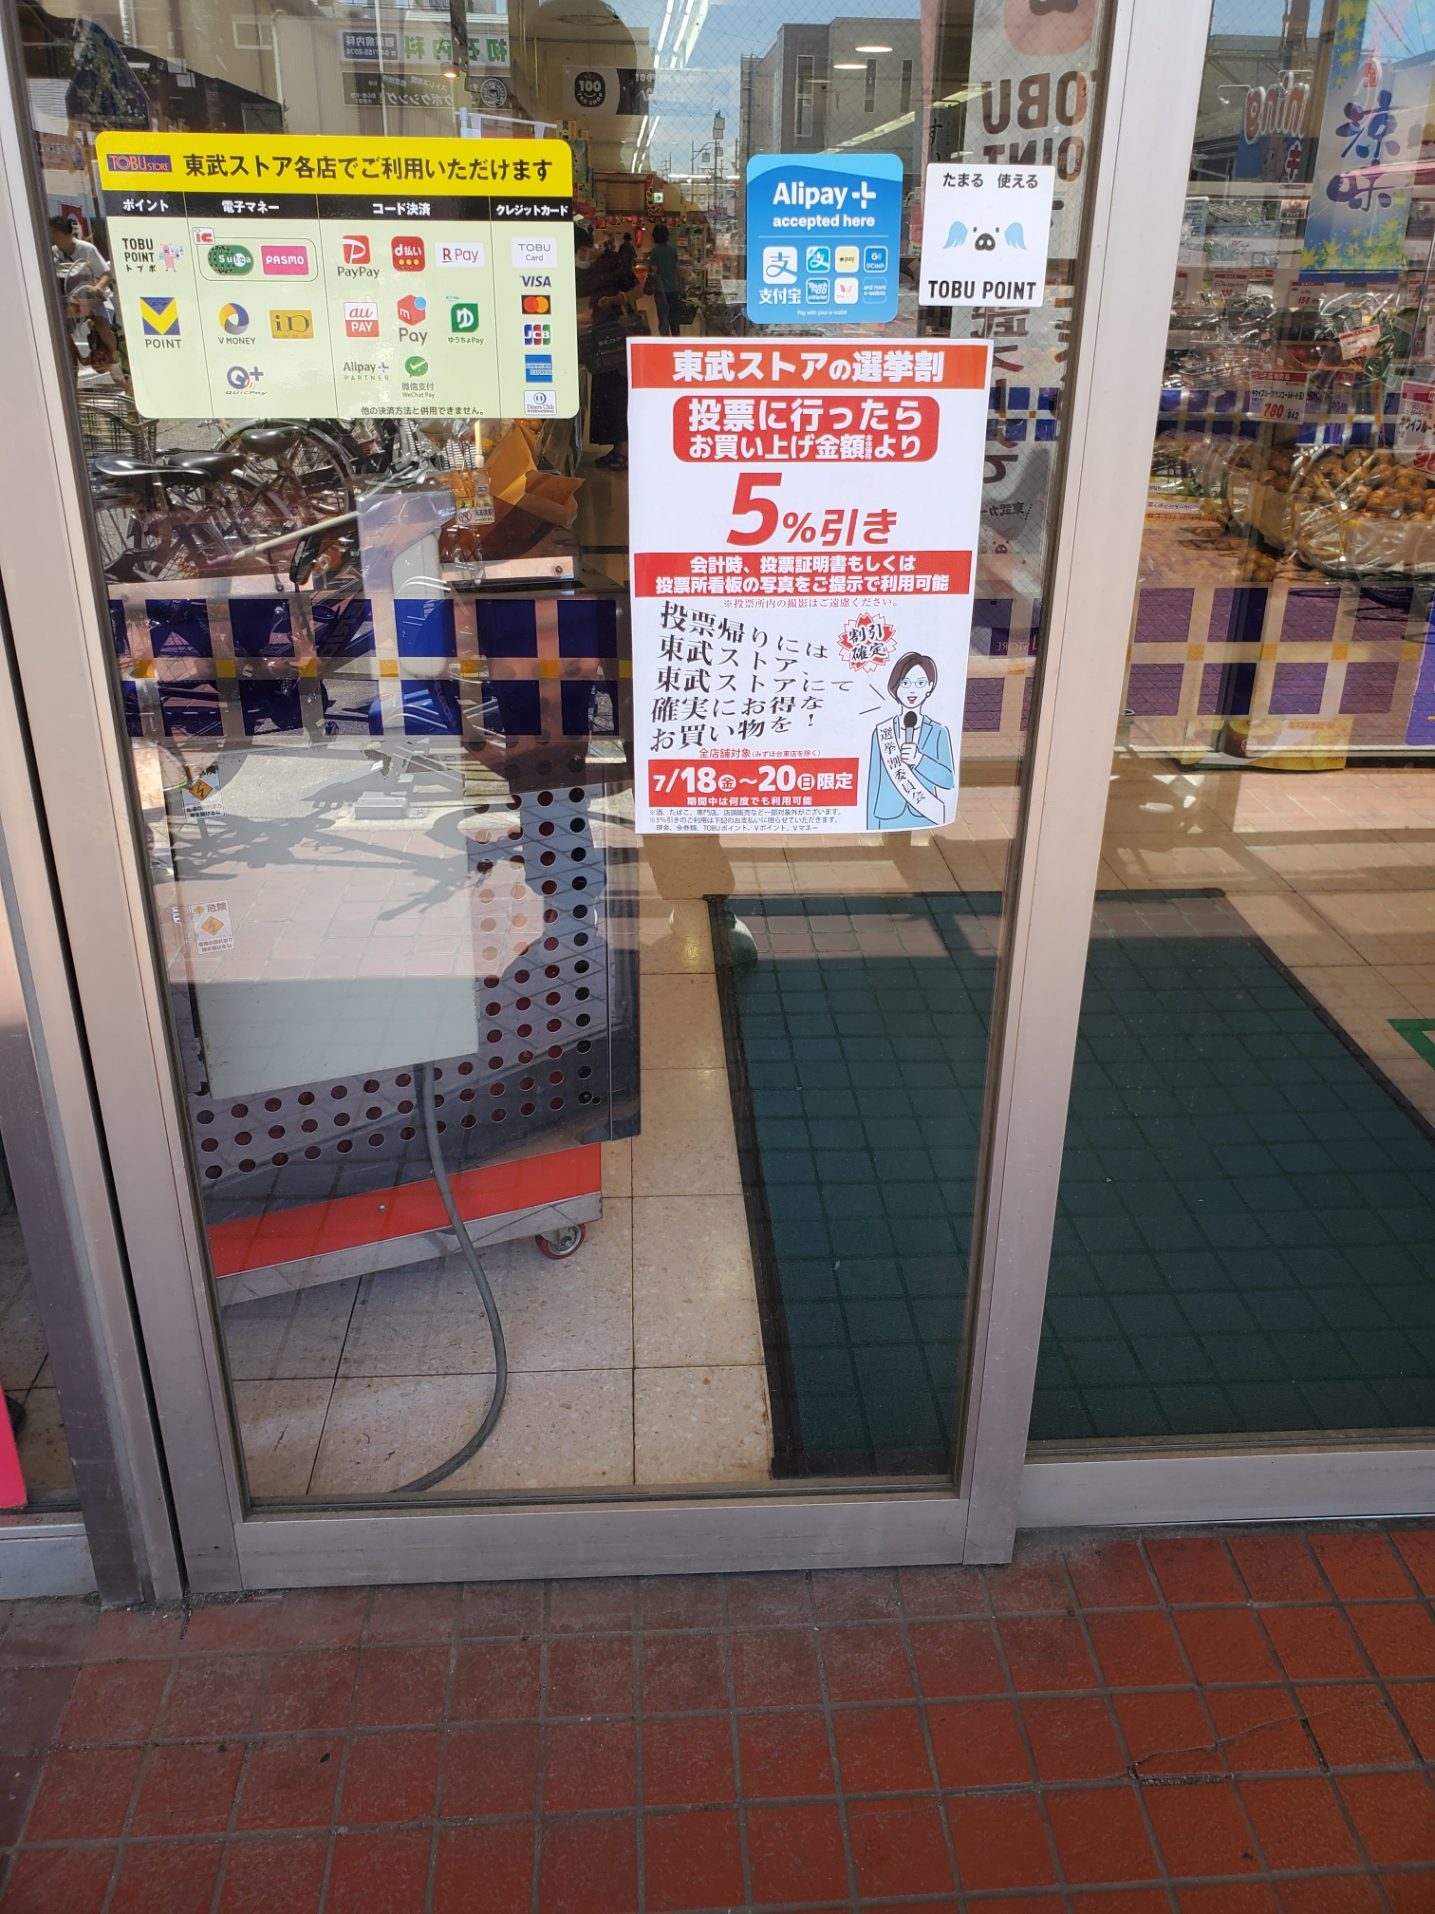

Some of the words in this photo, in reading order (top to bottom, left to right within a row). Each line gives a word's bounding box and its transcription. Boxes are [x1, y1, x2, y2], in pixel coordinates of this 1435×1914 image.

[579, 80, 602, 92] 100
[108, 155, 147, 171] TOBU
[183, 154, 552, 181] 東武ストア各店でご利用いただけます
[942, 172, 984, 188] たまる
[996, 173, 1039, 189] 使える
[123, 199, 169, 212] ポイント
[221, 201, 280, 214] 電子マネー
[372, 203, 431, 216] コード決済
[496, 204, 569, 217] クレジットカード
[772, 214, 841, 230] accepted
[843, 214, 875, 227] here
[121, 238, 154, 250] TOBU
[394, 245, 422, 256] d払い
[518, 244, 551, 252] TOBU
[124, 251, 155, 263] POINT
[218, 254, 252, 267] Suica
[265, 255, 305, 265] PASMO
[455, 249, 479, 263] Pay
[337, 267, 380, 279] PayPay
[520, 276, 552, 287] VISA
[759, 288, 801, 304] 支付宝
[928, 280, 974, 299] TOBU
[982, 281, 1036, 300] POINT
[348, 307, 373, 318] au
[351, 322, 373, 333] PAY
[228, 337, 256, 345] MONEY
[399, 327, 428, 346] Pay
[447, 336, 484, 345] ゆうちょPay
[145, 338, 182, 349] POINT
[672, 351, 945, 383] 東武ストアの選挙割
[402, 382, 434, 391] 微信支付
[360, 406, 485, 416] 他の決済方法と併用できません。
[688, 398, 923, 432] 投票に行ったら
[1264, 403, 1285, 418] 780
[690, 555, 916, 574] 会計時、投票証明書もしくは
[656, 574, 949, 593] 投票所看板の写真をご提示で利用可能
[660, 600, 828, 659] 投票帰りには
[849, 623, 883, 643] 割引
[851, 643, 887, 661] 確定
[654, 665, 854, 693] 東武ストアにて
[651, 696, 824, 724] 確実にお得な
[687, 796, 813, 806] 期間中は何度でも利用可能
